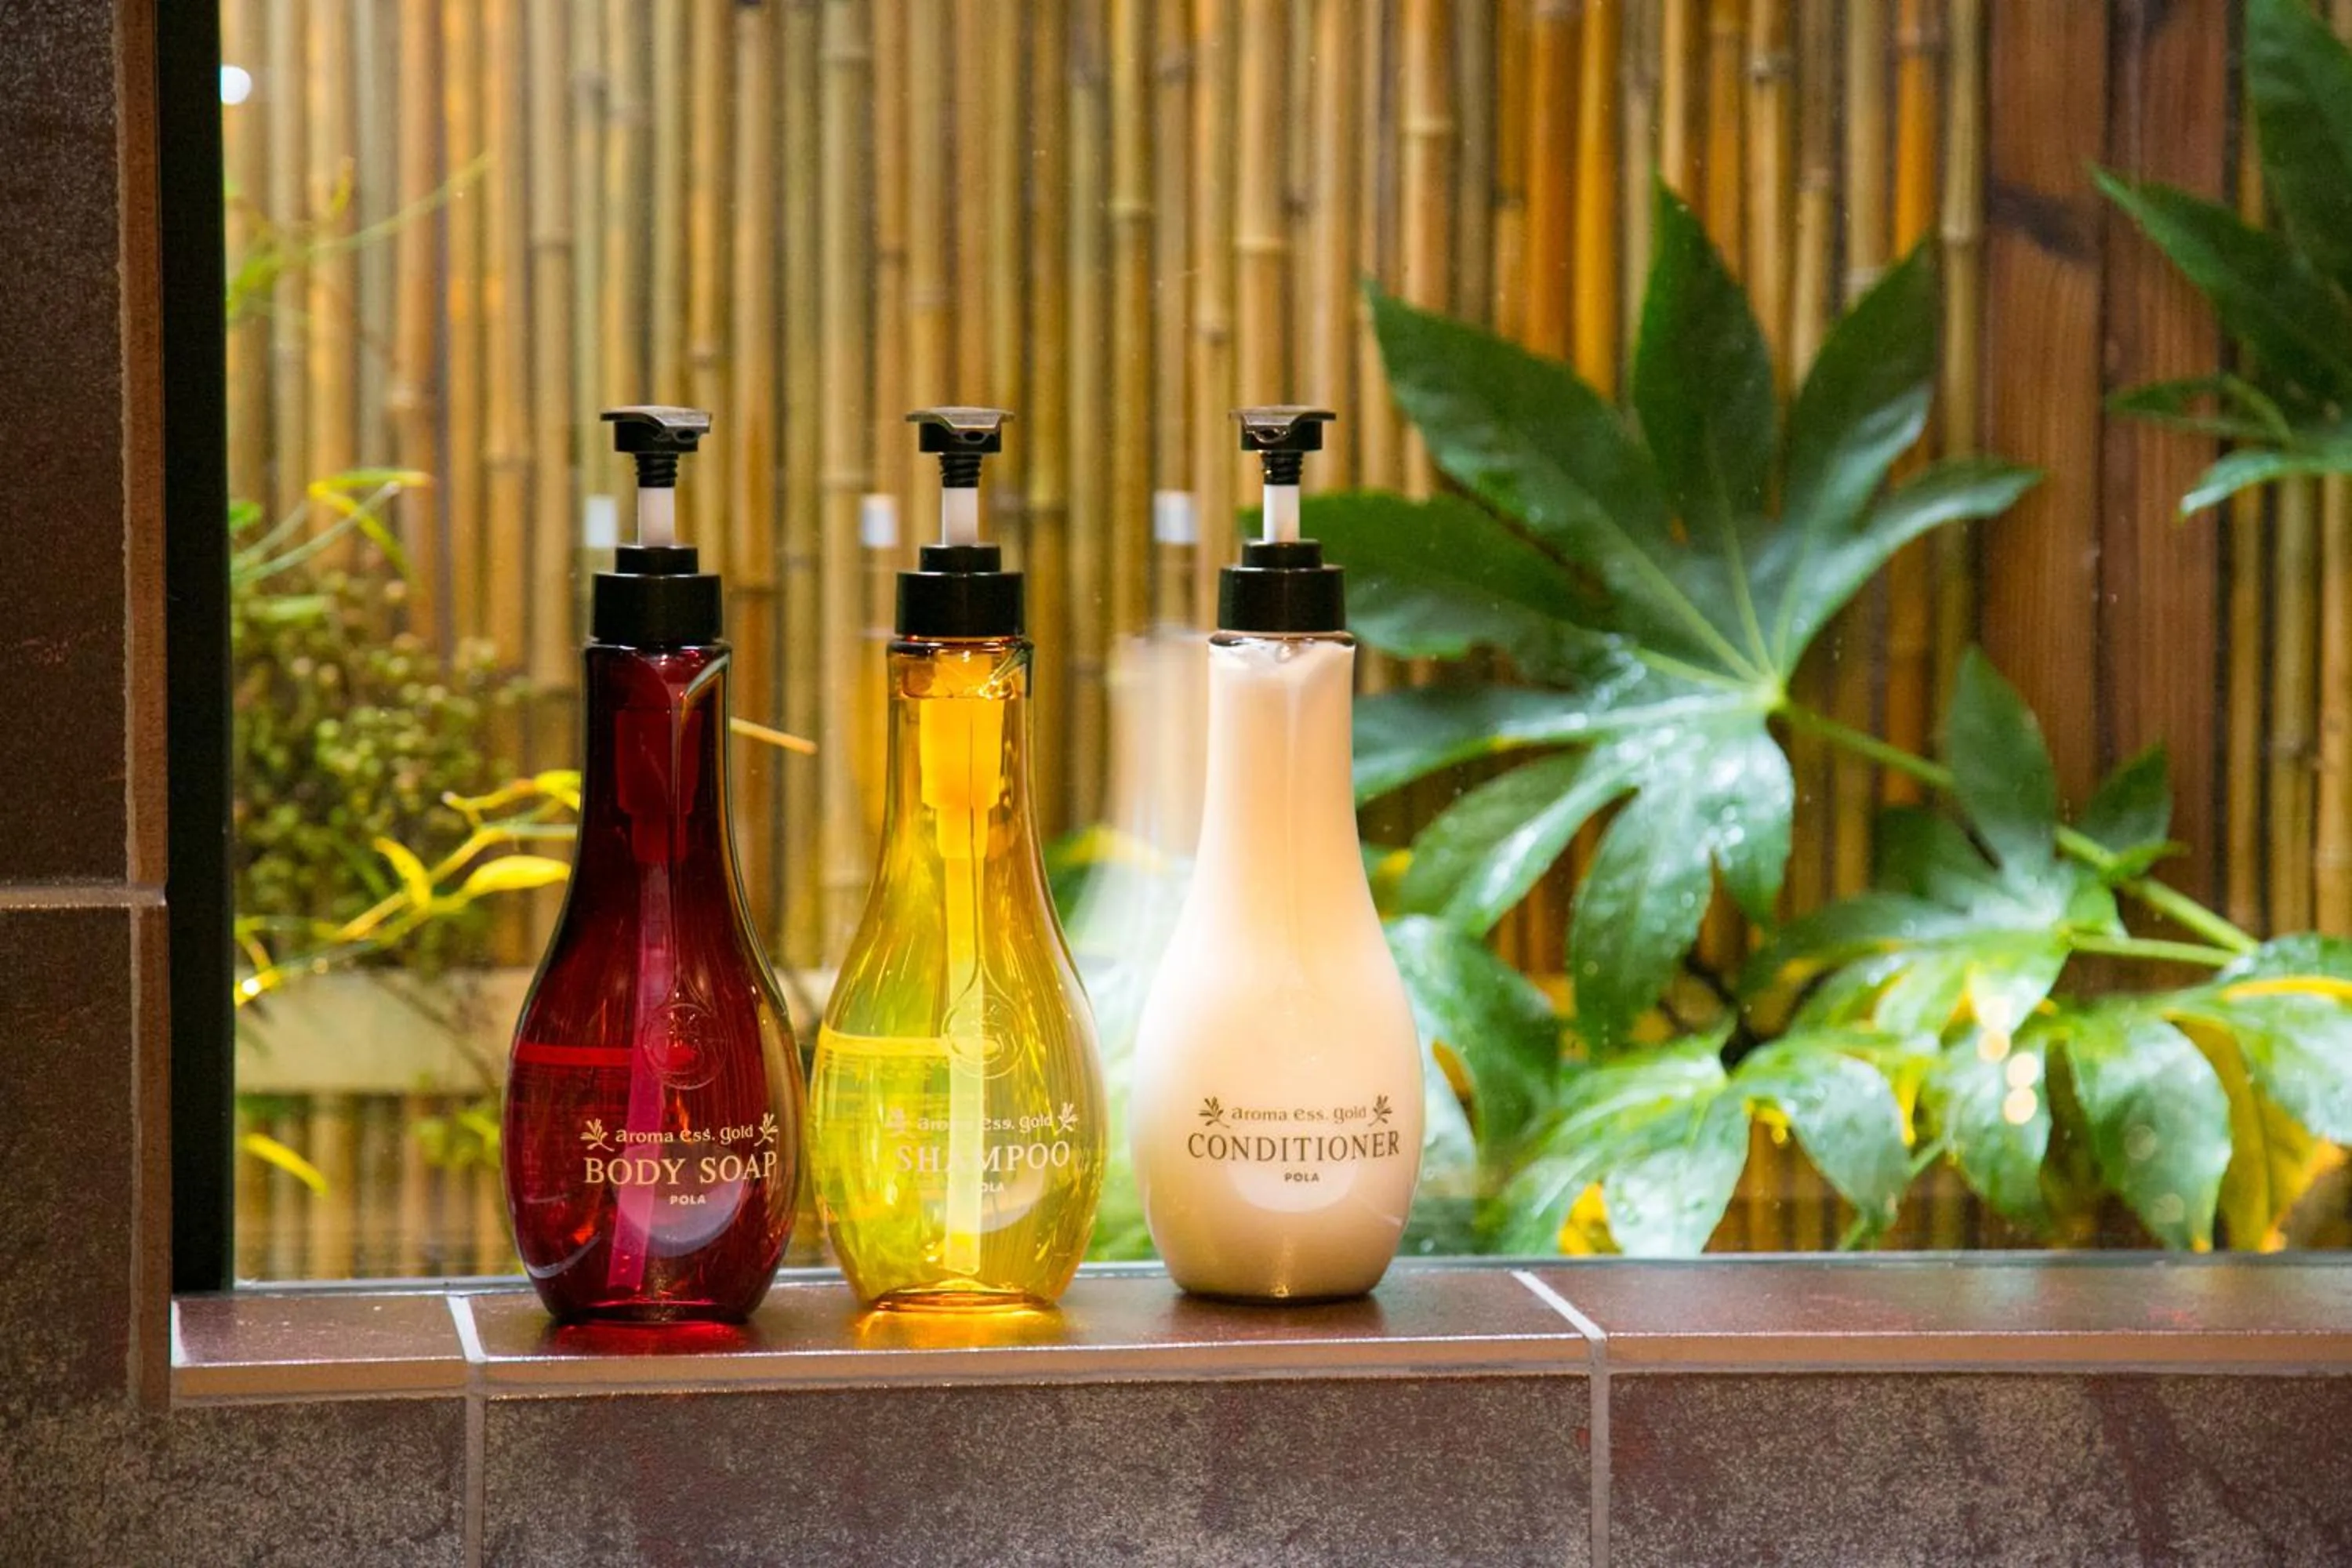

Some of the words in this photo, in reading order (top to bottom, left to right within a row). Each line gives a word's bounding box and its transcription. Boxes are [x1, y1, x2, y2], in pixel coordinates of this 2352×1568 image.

[1019, 1113, 1053, 1133] gold
[1231, 1106, 1287, 1122] aroma
[1294, 1106, 1328, 1121] ess.
[1334, 1105, 1367, 1124] gold
[615, 1127, 673, 1144] aroma
[680, 1127, 715, 1142] ess.
[720, 1123, 754, 1145] gold
[1187, 1130, 1399, 1162] CONDITIONER
[583, 1156, 686, 1186] BODY
[699, 1151, 778, 1185] SOAP
[1284, 1172, 1320, 1182] POLA
[971, 1181, 1005, 1193] OLA
[670, 1194, 706, 1205] POLA
